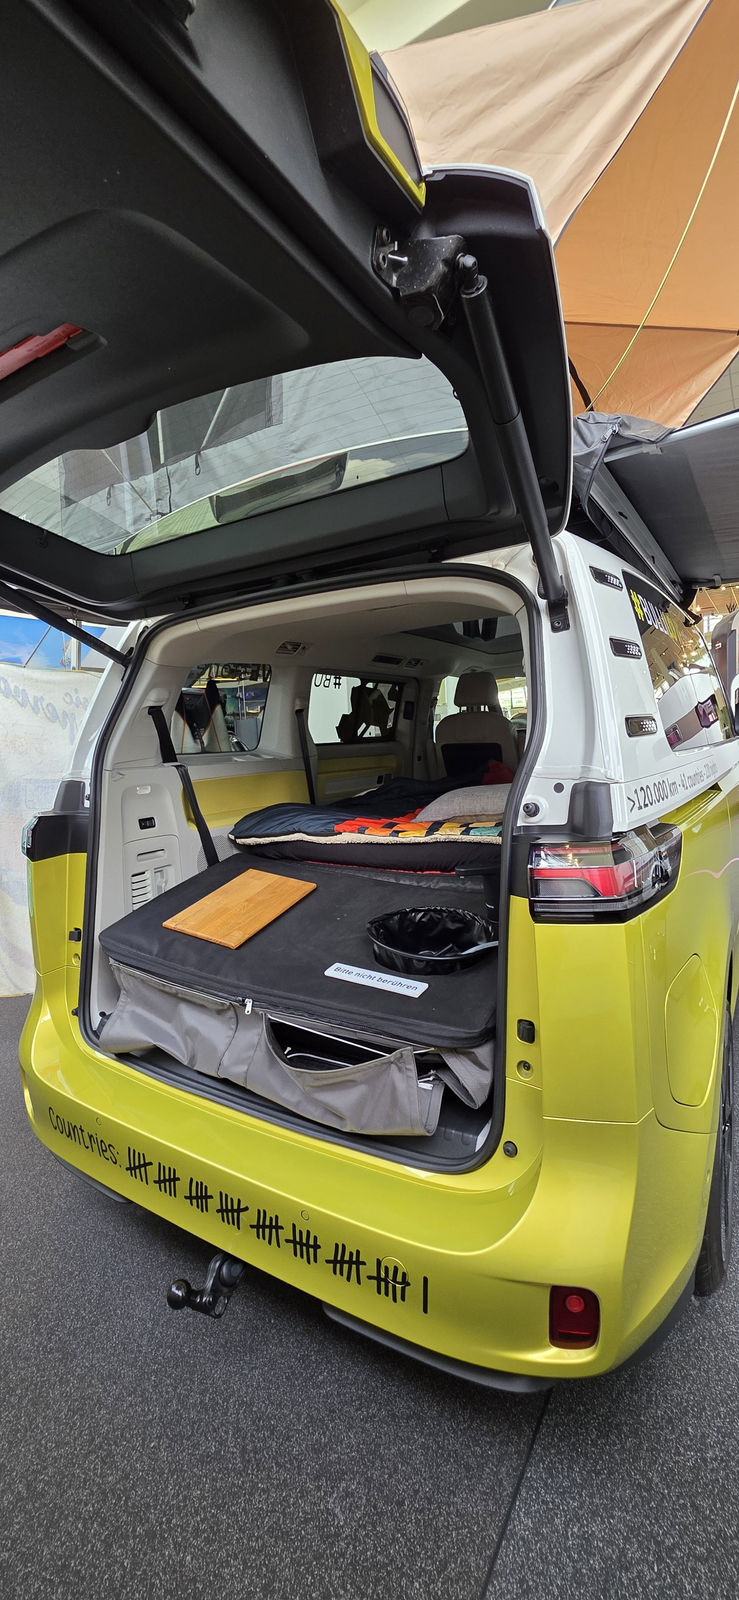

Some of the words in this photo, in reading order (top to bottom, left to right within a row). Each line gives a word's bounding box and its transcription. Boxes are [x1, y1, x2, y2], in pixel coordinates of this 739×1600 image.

[667, 778, 679, 796] km
[334, 966, 354, 976] Bitte
[354, 971, 376, 981] nicht
[376, 977, 418, 991] berühren
[48, 1107, 122, 1168] Countries:
